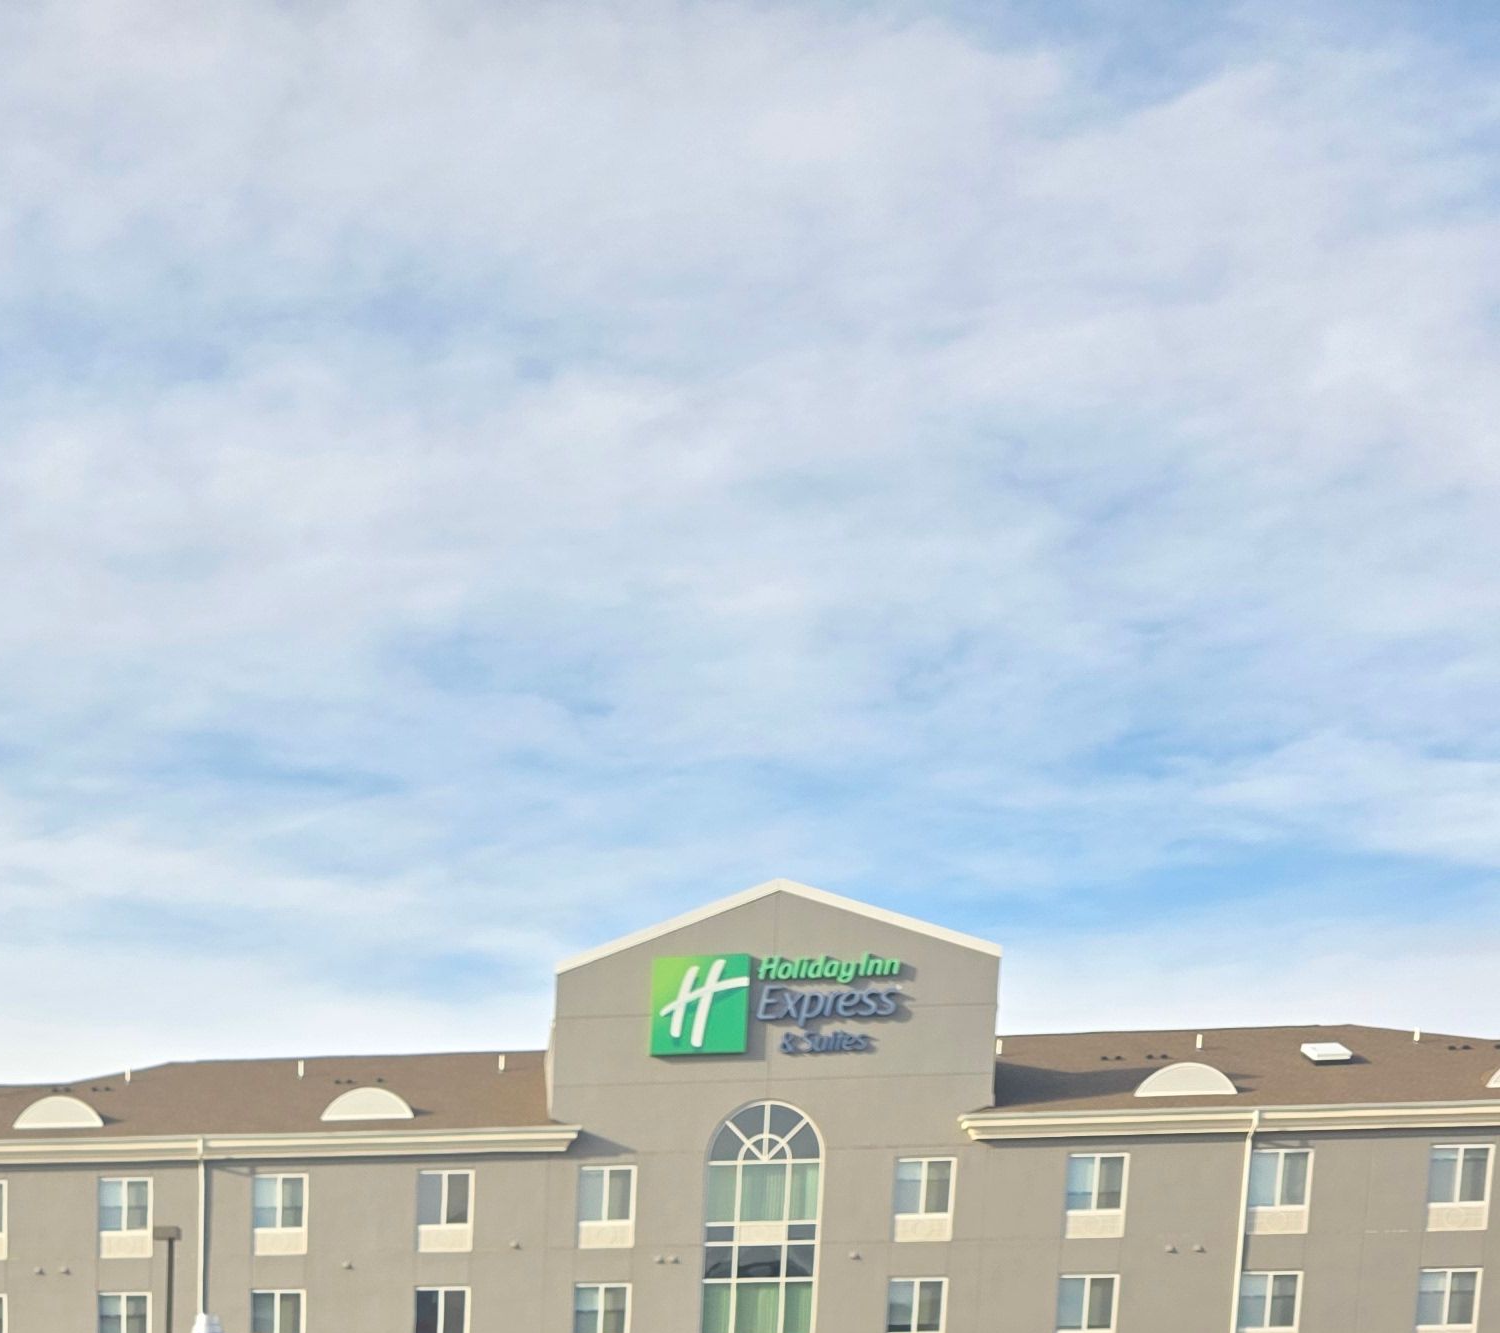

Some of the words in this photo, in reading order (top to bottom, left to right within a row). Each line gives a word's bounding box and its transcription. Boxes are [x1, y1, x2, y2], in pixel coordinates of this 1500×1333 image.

[758, 956, 855, 983] Holiday
[858, 952, 901, 977] Inn
[756, 984, 897, 1027] Express
[780, 1033, 796, 1053] &
[802, 1030, 869, 1053] Suites
